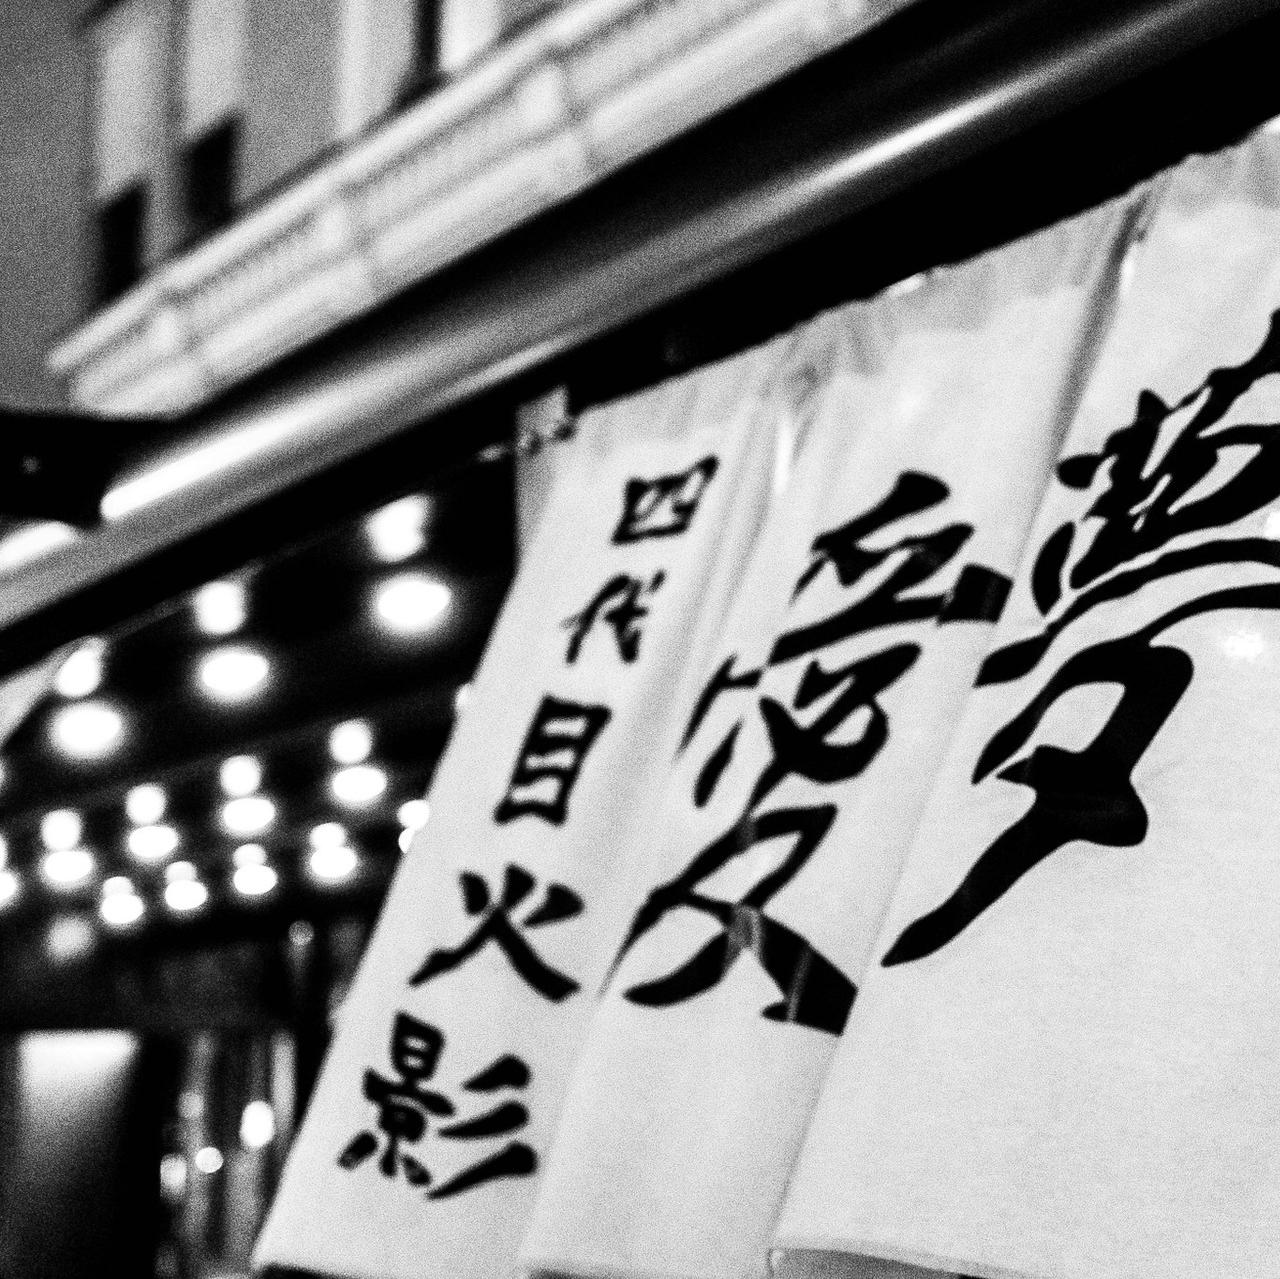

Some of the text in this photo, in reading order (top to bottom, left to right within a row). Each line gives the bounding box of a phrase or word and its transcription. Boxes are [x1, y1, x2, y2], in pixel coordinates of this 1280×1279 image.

[339, 456, 718, 1200] 四代目火影
